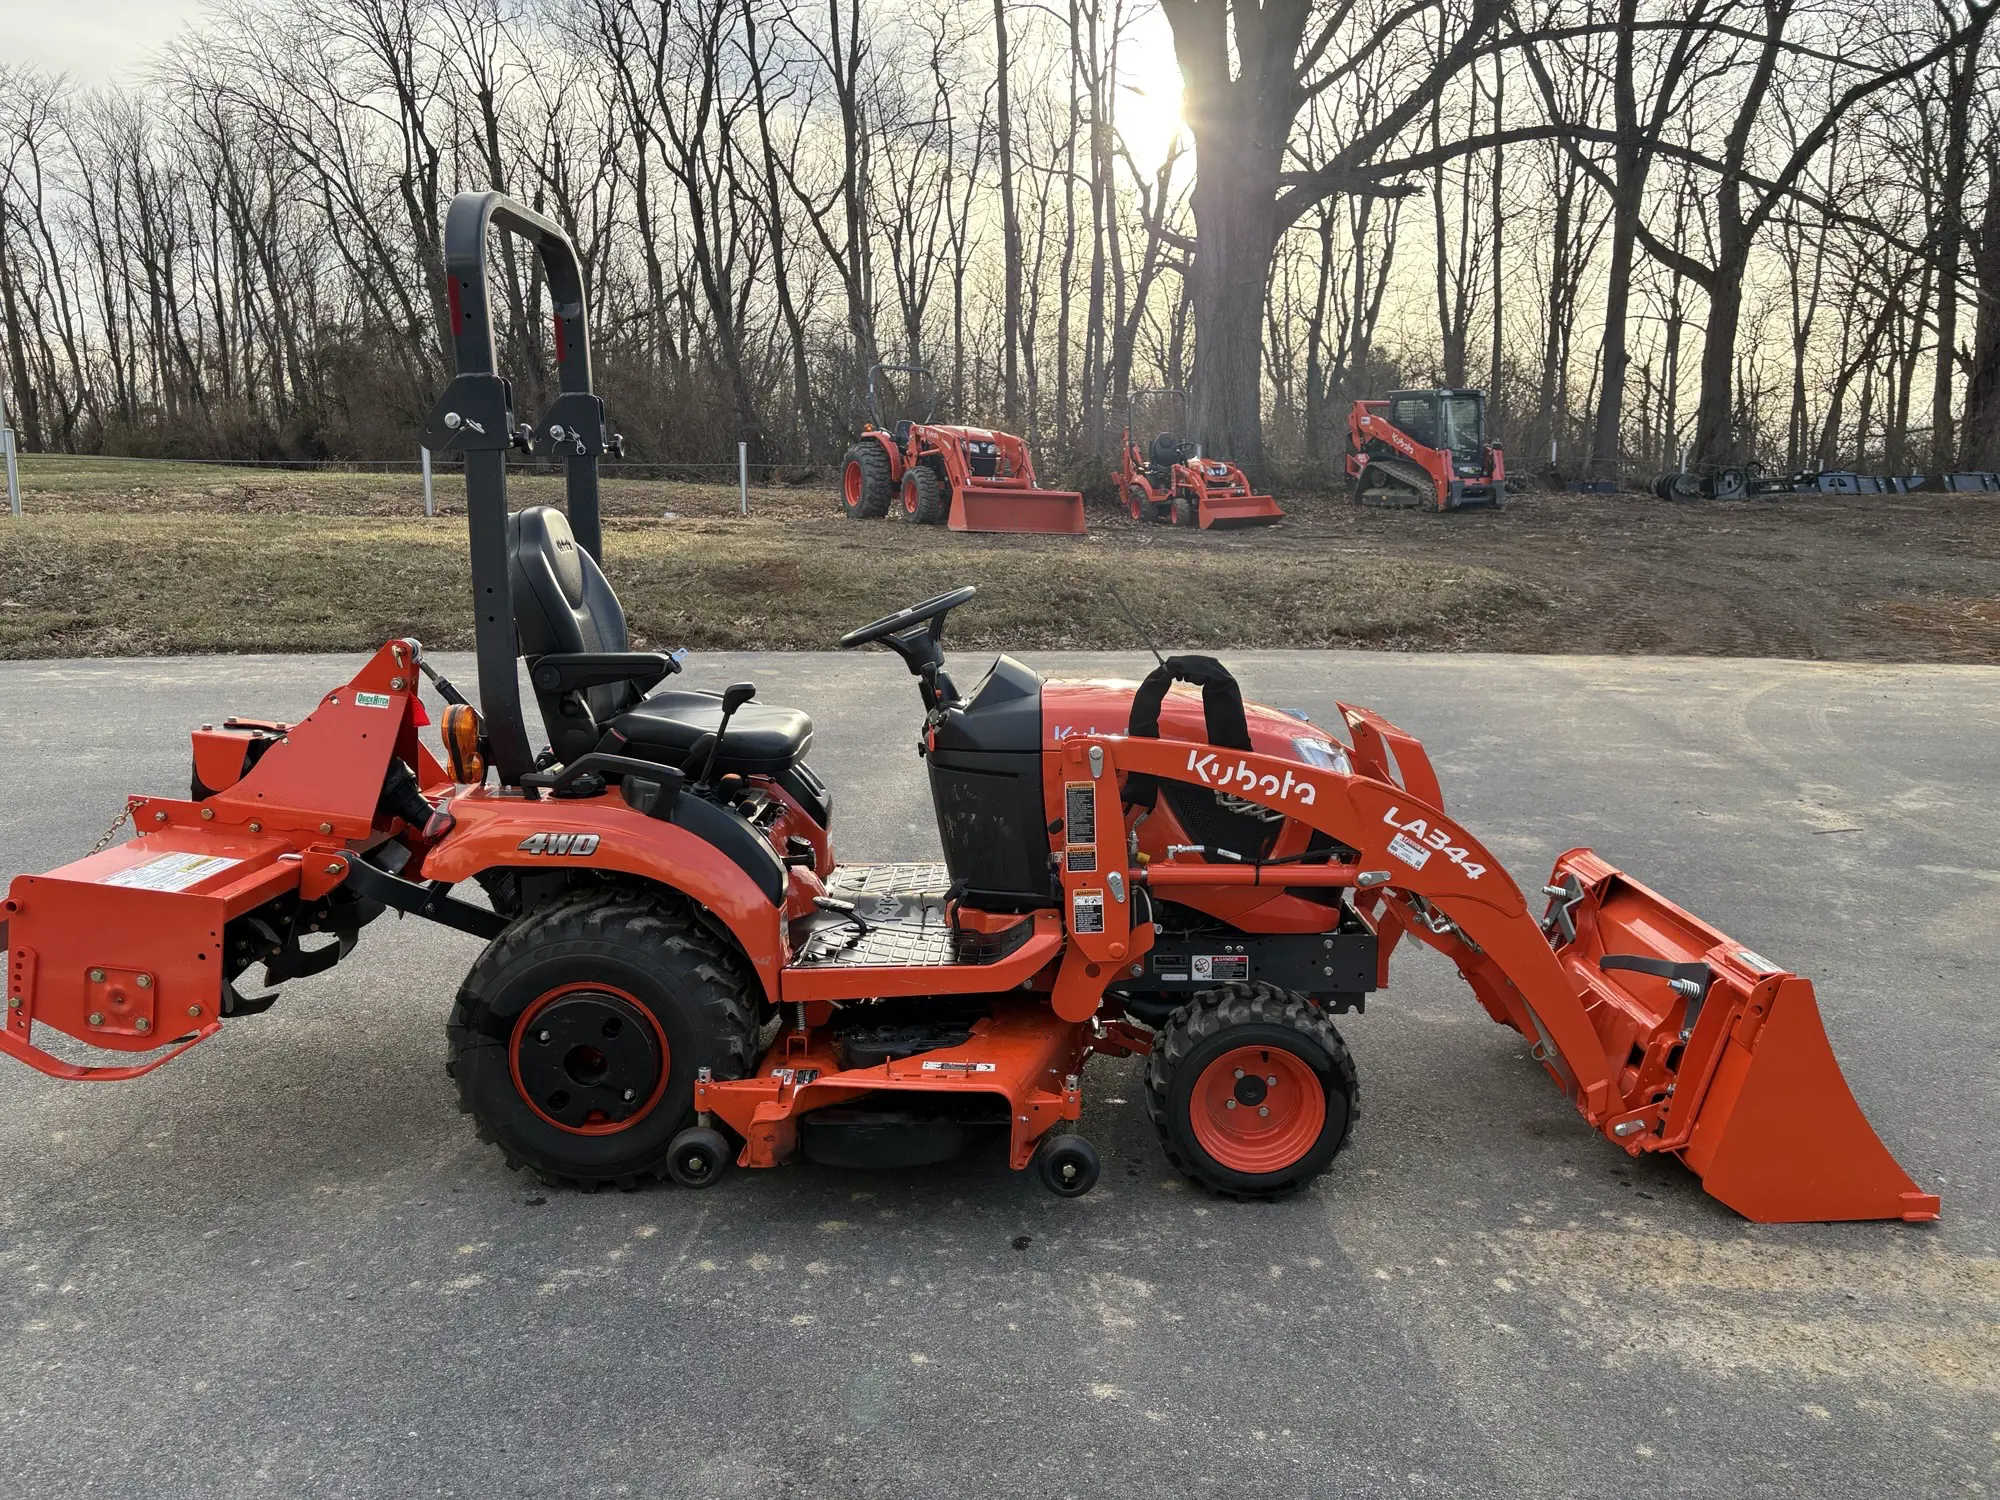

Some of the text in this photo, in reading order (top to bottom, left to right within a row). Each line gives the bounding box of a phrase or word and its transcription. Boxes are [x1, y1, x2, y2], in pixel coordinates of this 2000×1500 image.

[1187, 750, 1316, 805] Kubota
[517, 832, 601, 857] 4WD
[1383, 806, 1487, 880] LA344
